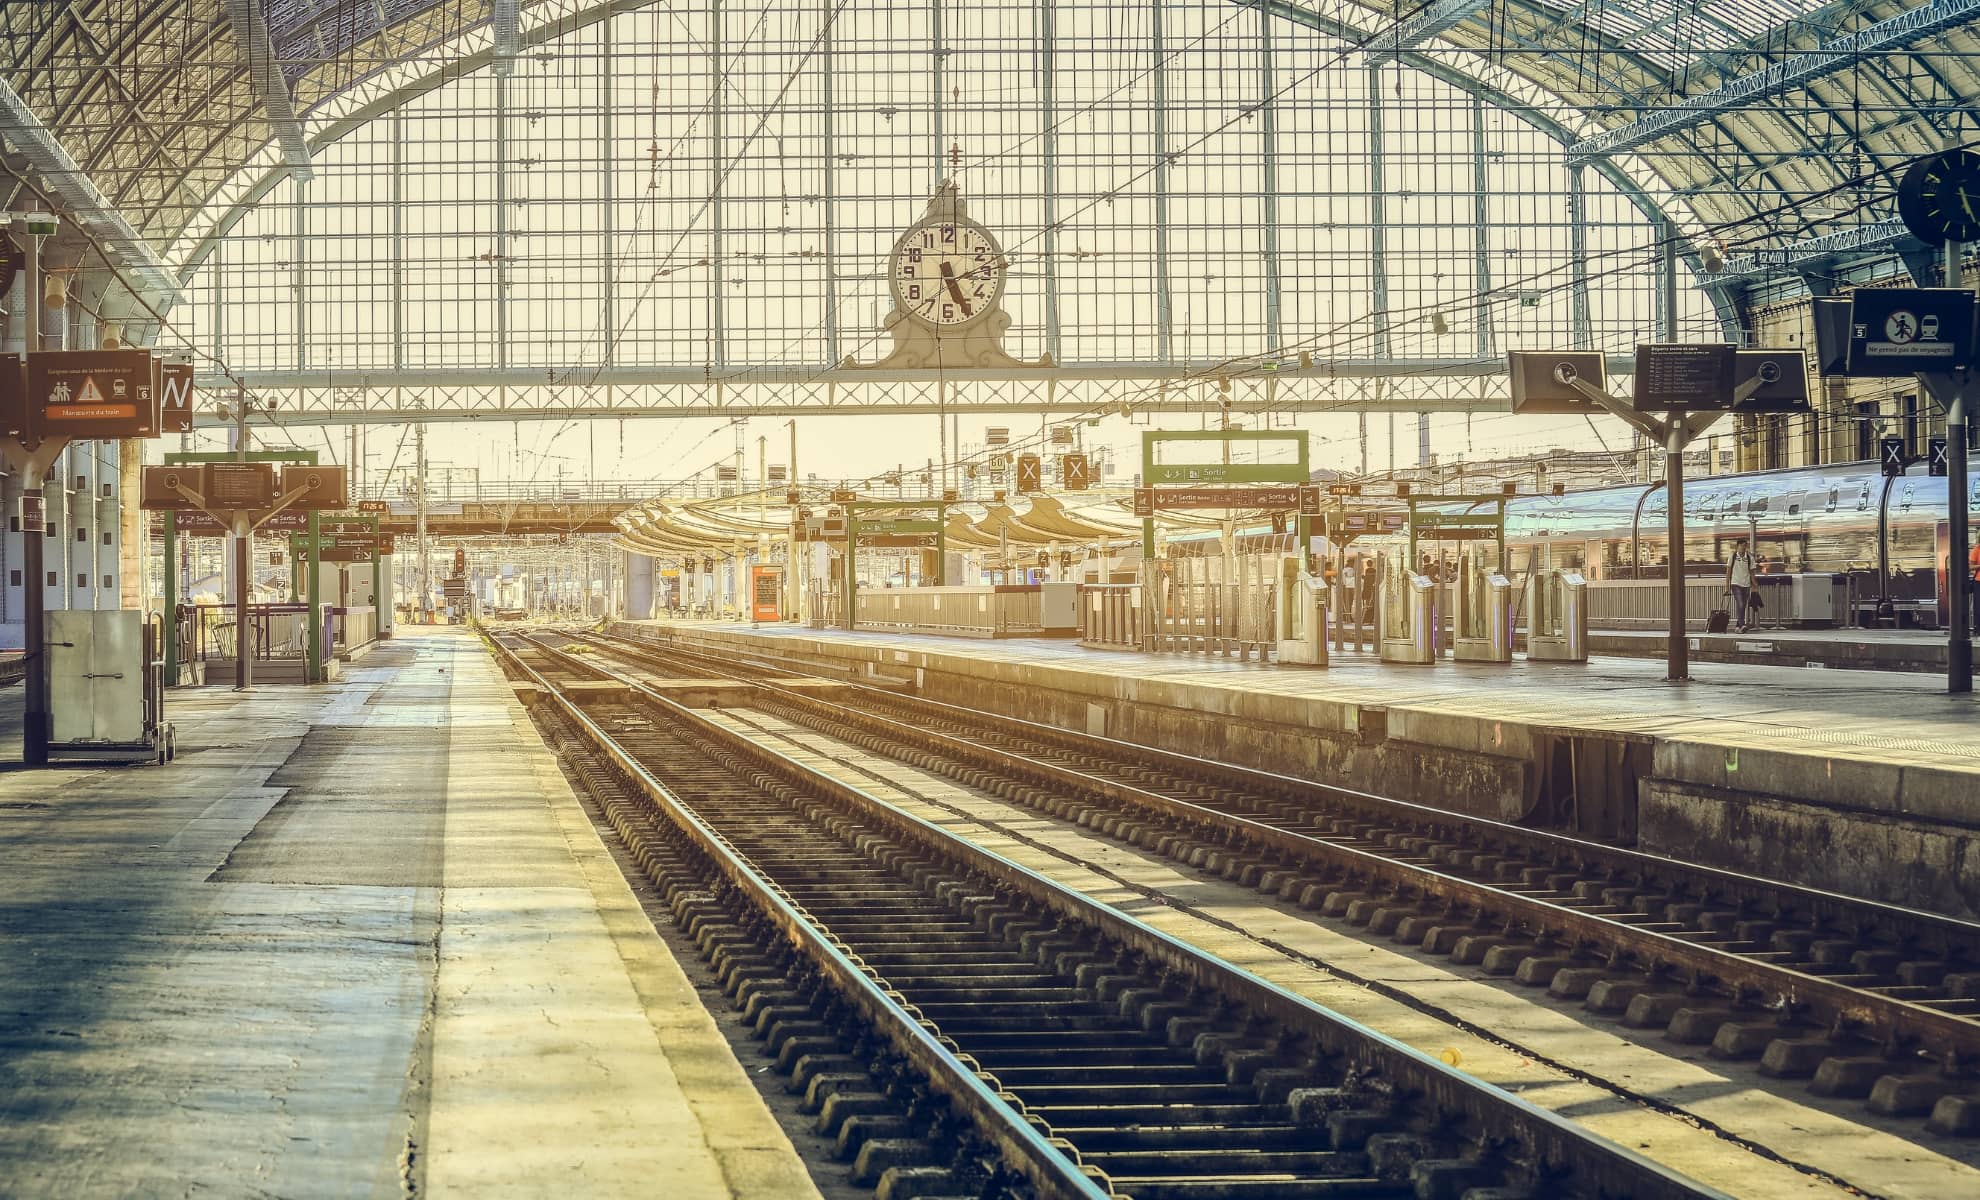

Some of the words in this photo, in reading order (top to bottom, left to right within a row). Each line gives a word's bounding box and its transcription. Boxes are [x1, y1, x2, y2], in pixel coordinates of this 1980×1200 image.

[923, 233, 934, 248] 11
[940, 228, 954, 243] 12
[964, 233, 969, 248] 1
[909, 248, 922, 263] 10
[974, 246, 986, 262] 2
[904, 266, 915, 279] 9
[980, 266, 991, 281] 3
[909, 284, 921, 300] 8
[973, 283, 985, 299] 4
[925, 298, 936, 315] 7
[942, 303, 954, 318] 6
[1857, 329, 1863, 337] 5
[141, 391, 148, 399] 6
[162, 377, 191, 408] N
[1887, 445, 1900, 462] X
[1934, 445, 1948, 462] X
[991, 457, 1003, 466] 60
[1023, 462, 1036, 479] X
[1070, 461, 1083, 478] X
[1203, 467, 1226, 475] Sortie
[1179, 493, 1196, 501] Sortie
[1275, 515, 1284, 527] Y
